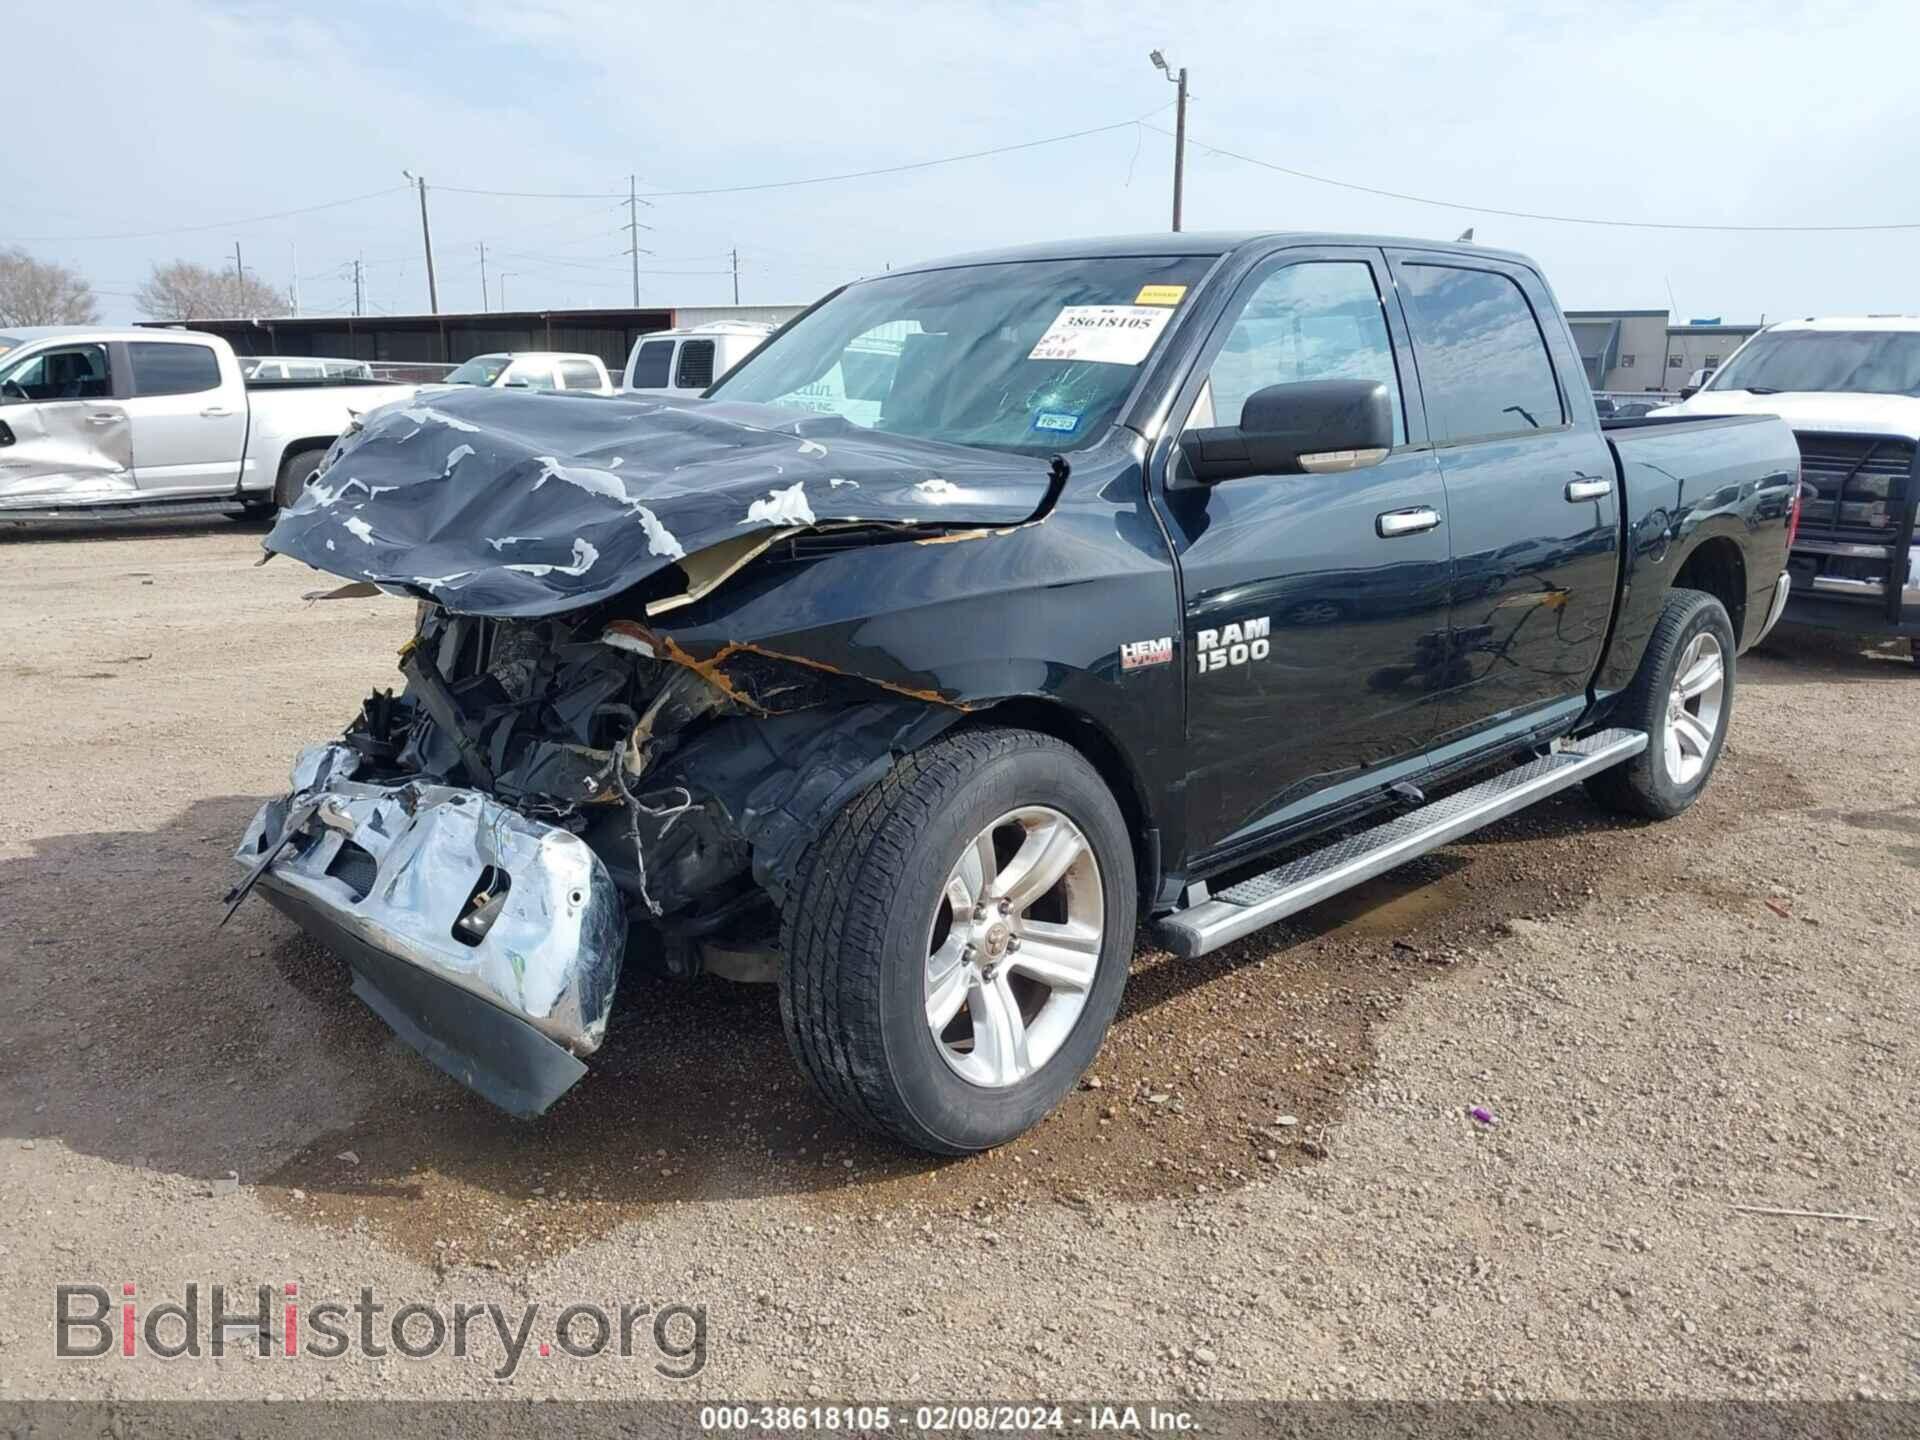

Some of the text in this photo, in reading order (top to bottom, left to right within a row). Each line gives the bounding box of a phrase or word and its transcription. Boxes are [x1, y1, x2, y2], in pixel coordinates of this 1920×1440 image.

[1061, 316, 1154, 329] 38618105
[1120, 636, 1173, 657] HEMI
[1197, 616, 1271, 651] RAM
[1196, 638, 1270, 674] 1500
